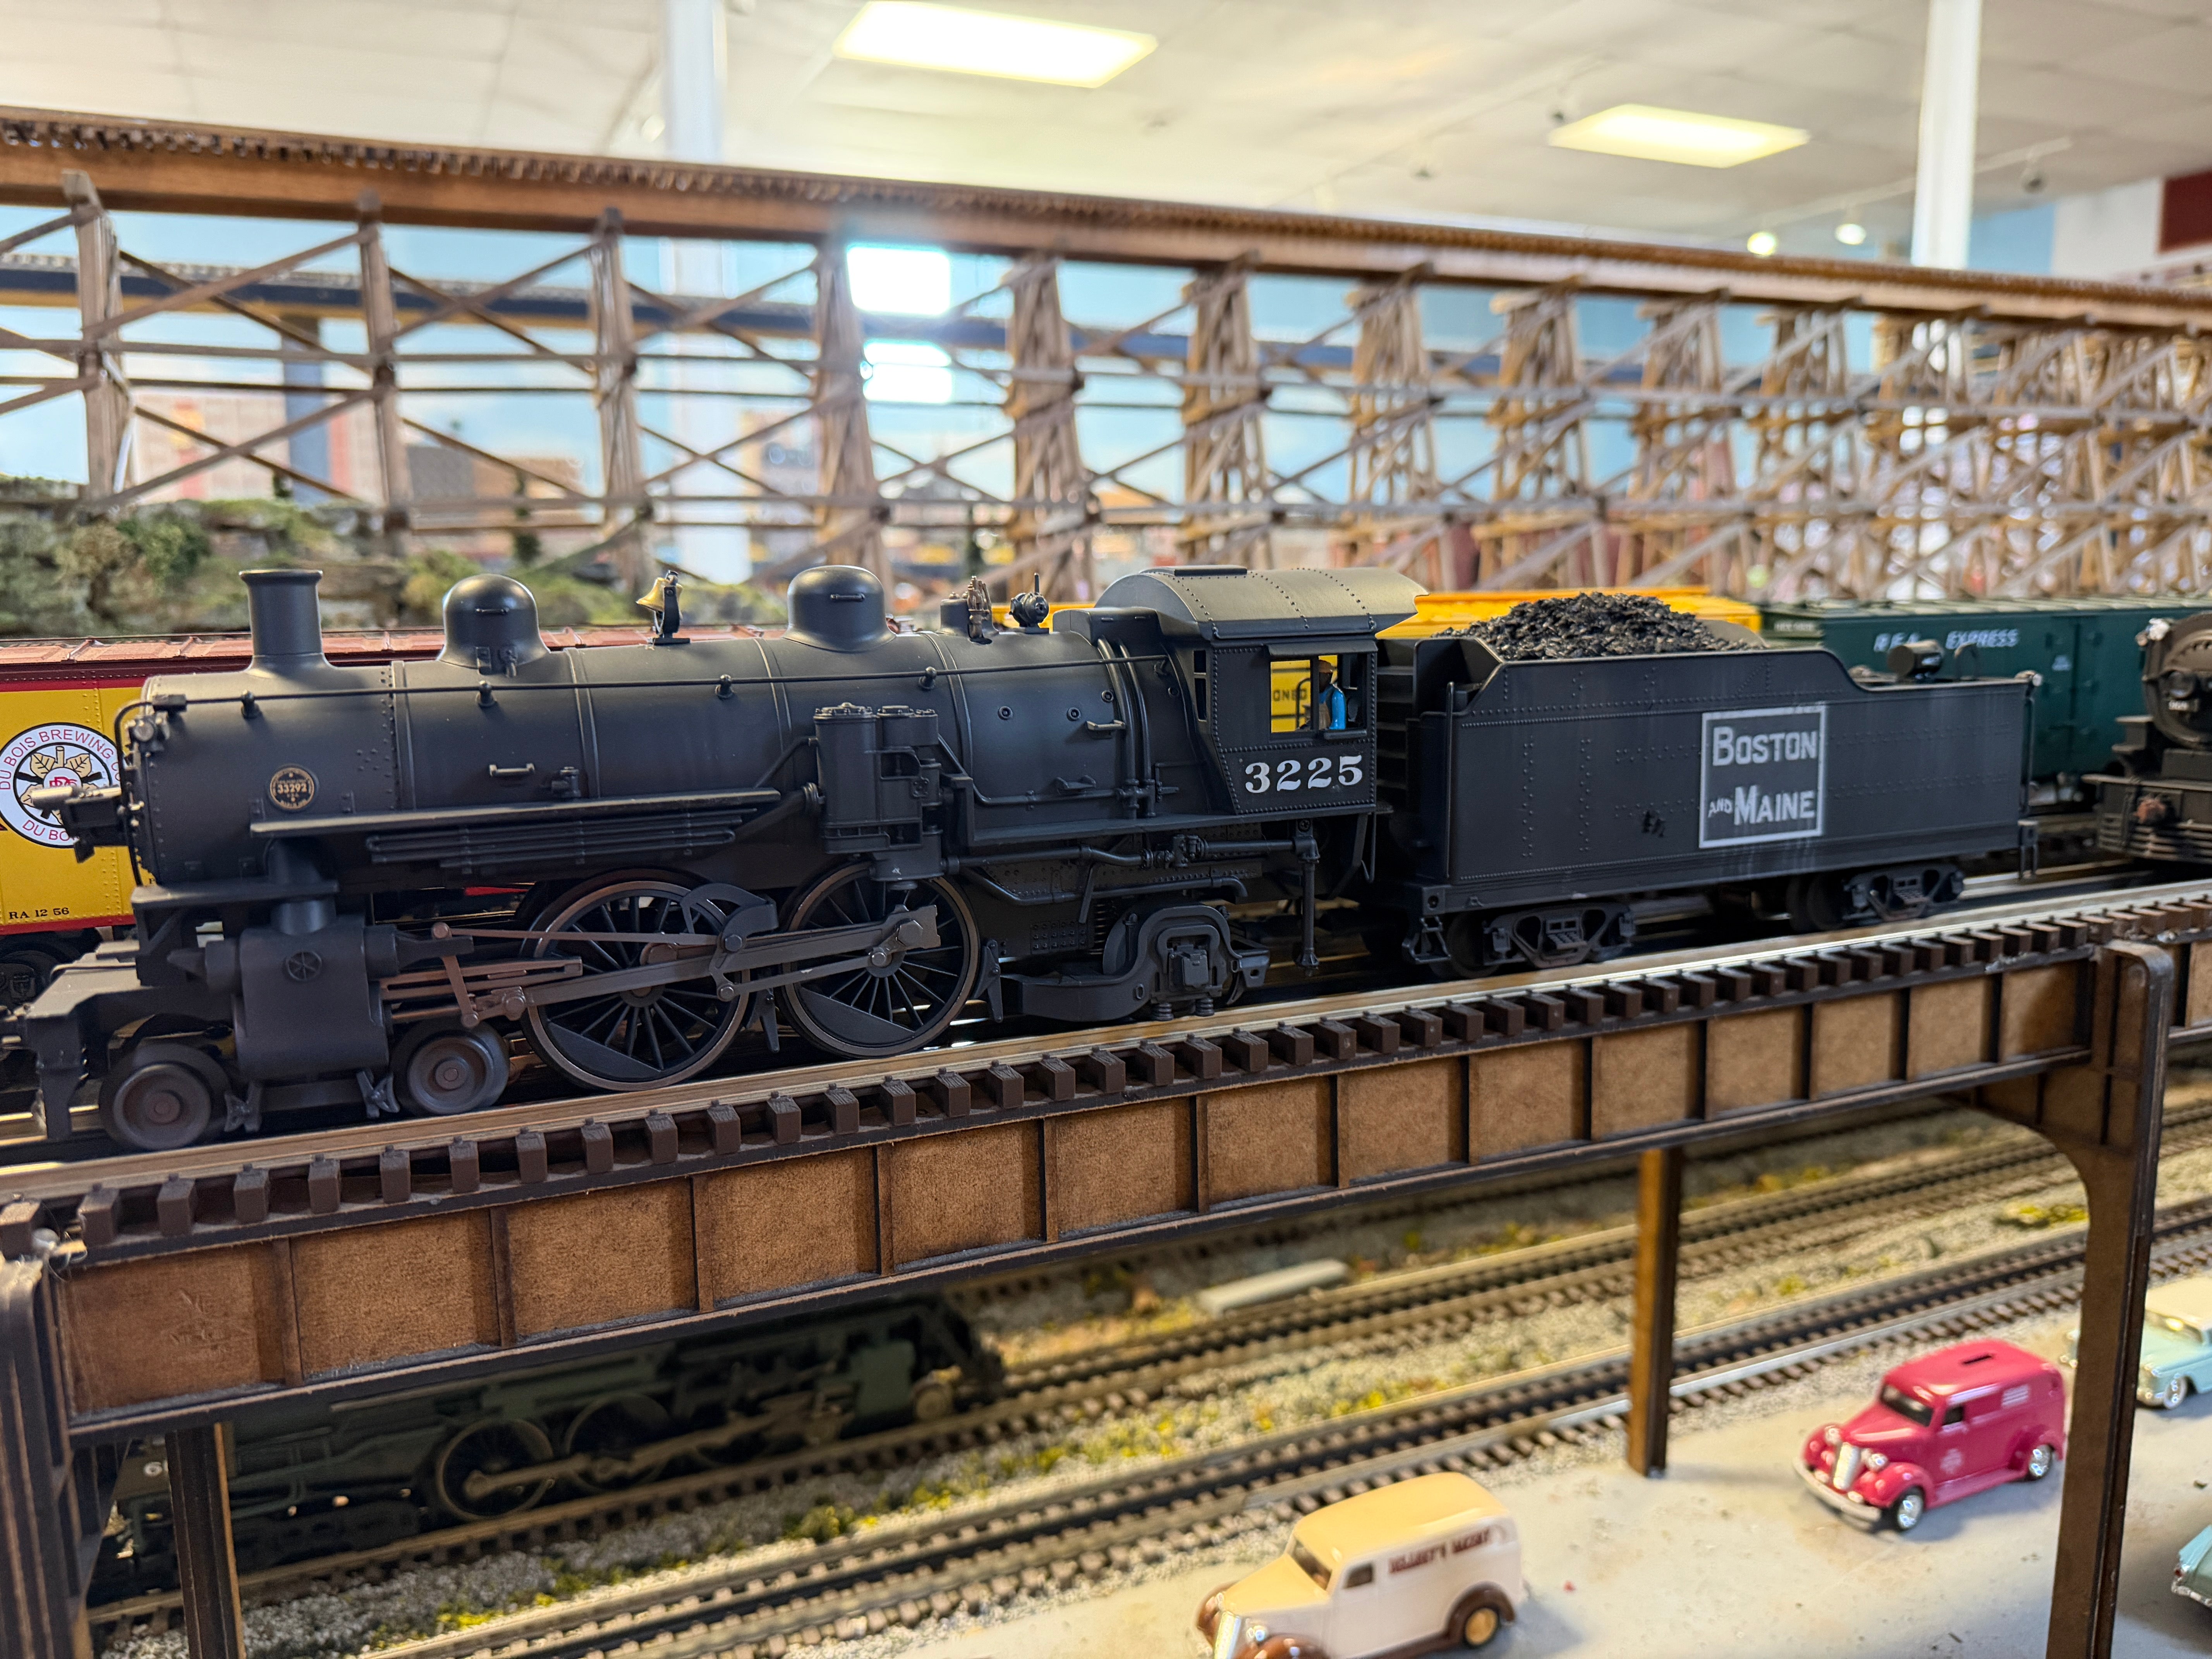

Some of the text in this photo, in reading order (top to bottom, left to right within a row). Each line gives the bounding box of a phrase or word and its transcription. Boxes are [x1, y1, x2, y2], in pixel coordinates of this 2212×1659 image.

[4, 737, 36, 767] BOIS
[39, 729, 113, 759] BREWING
[1712, 726, 1818, 766] BOSTON
[1245, 755, 1362, 793] 3225
[1708, 785, 1815, 826] AND MAINE
[22, 819, 45, 836] DU
